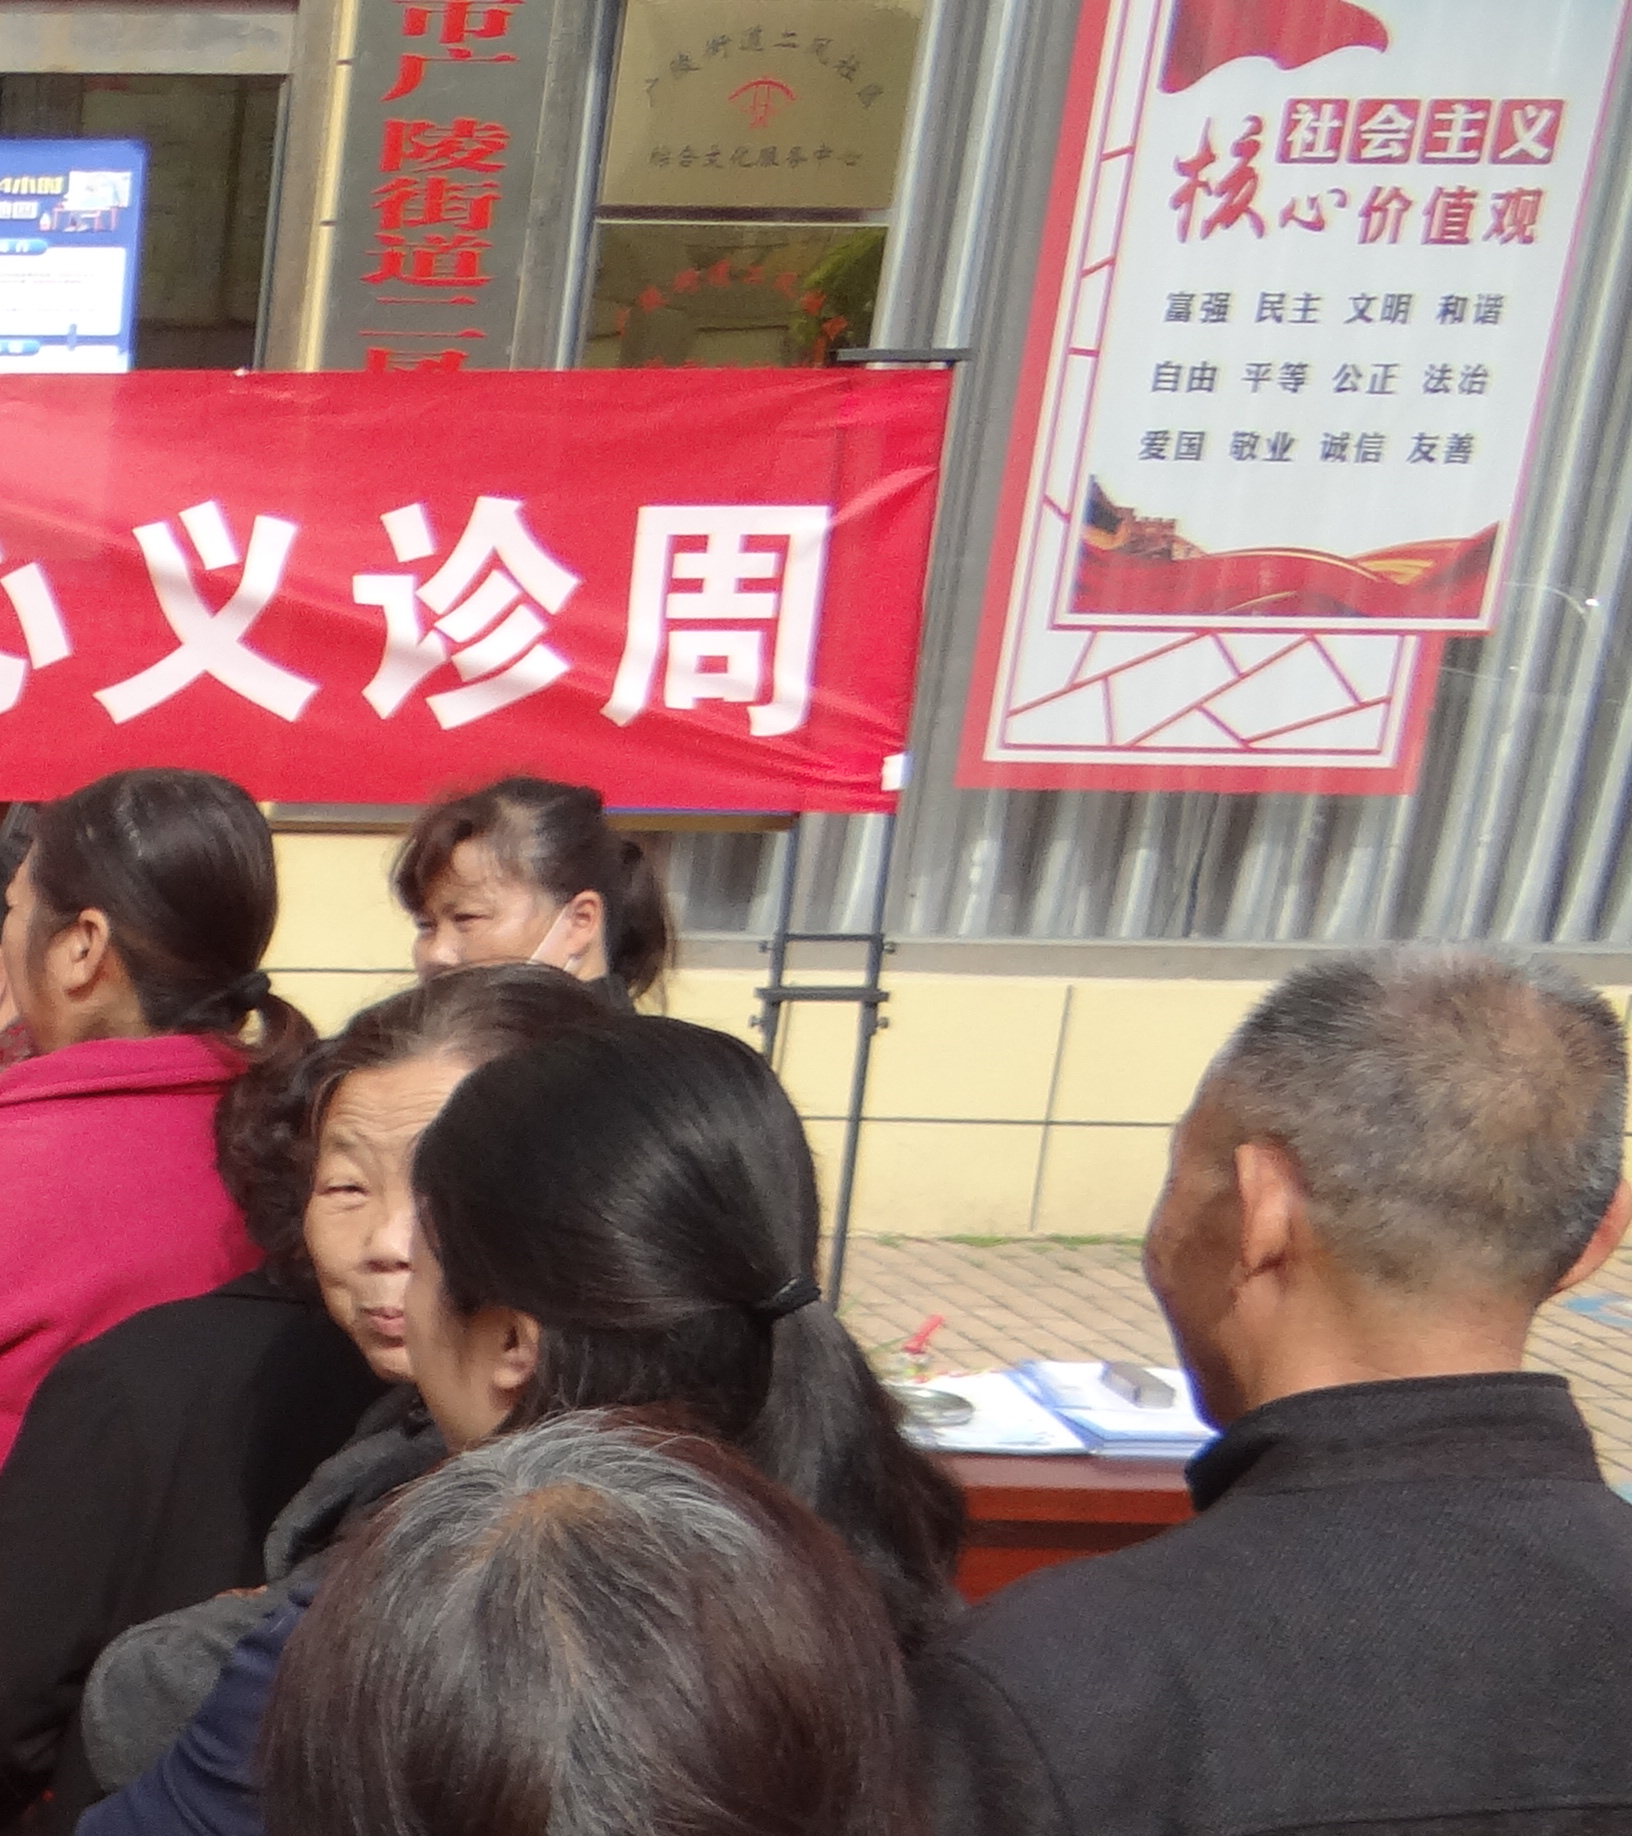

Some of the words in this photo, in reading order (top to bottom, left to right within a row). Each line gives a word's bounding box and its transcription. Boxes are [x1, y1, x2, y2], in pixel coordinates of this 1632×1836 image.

[1284, 102, 1554, 161] 社会主义
[1169, 114, 1544, 243] 核心价值观
[1163, 292, 1232, 325] 富强
[1255, 292, 1322, 325] 民主
[1343, 292, 1415, 325] 文明
[1436, 292, 1504, 325] 和谐
[1150, 361, 1219, 395] 自由
[1241, 361, 1310, 395] 平等
[1332, 361, 1401, 395] 公正
[1422, 361, 1491, 395] 法治
[1138, 429, 1206, 464] 爱国
[1230, 429, 1296, 464] 敬业
[1320, 429, 1387, 464] 诚信
[1406, 429, 1475, 464] 友善
